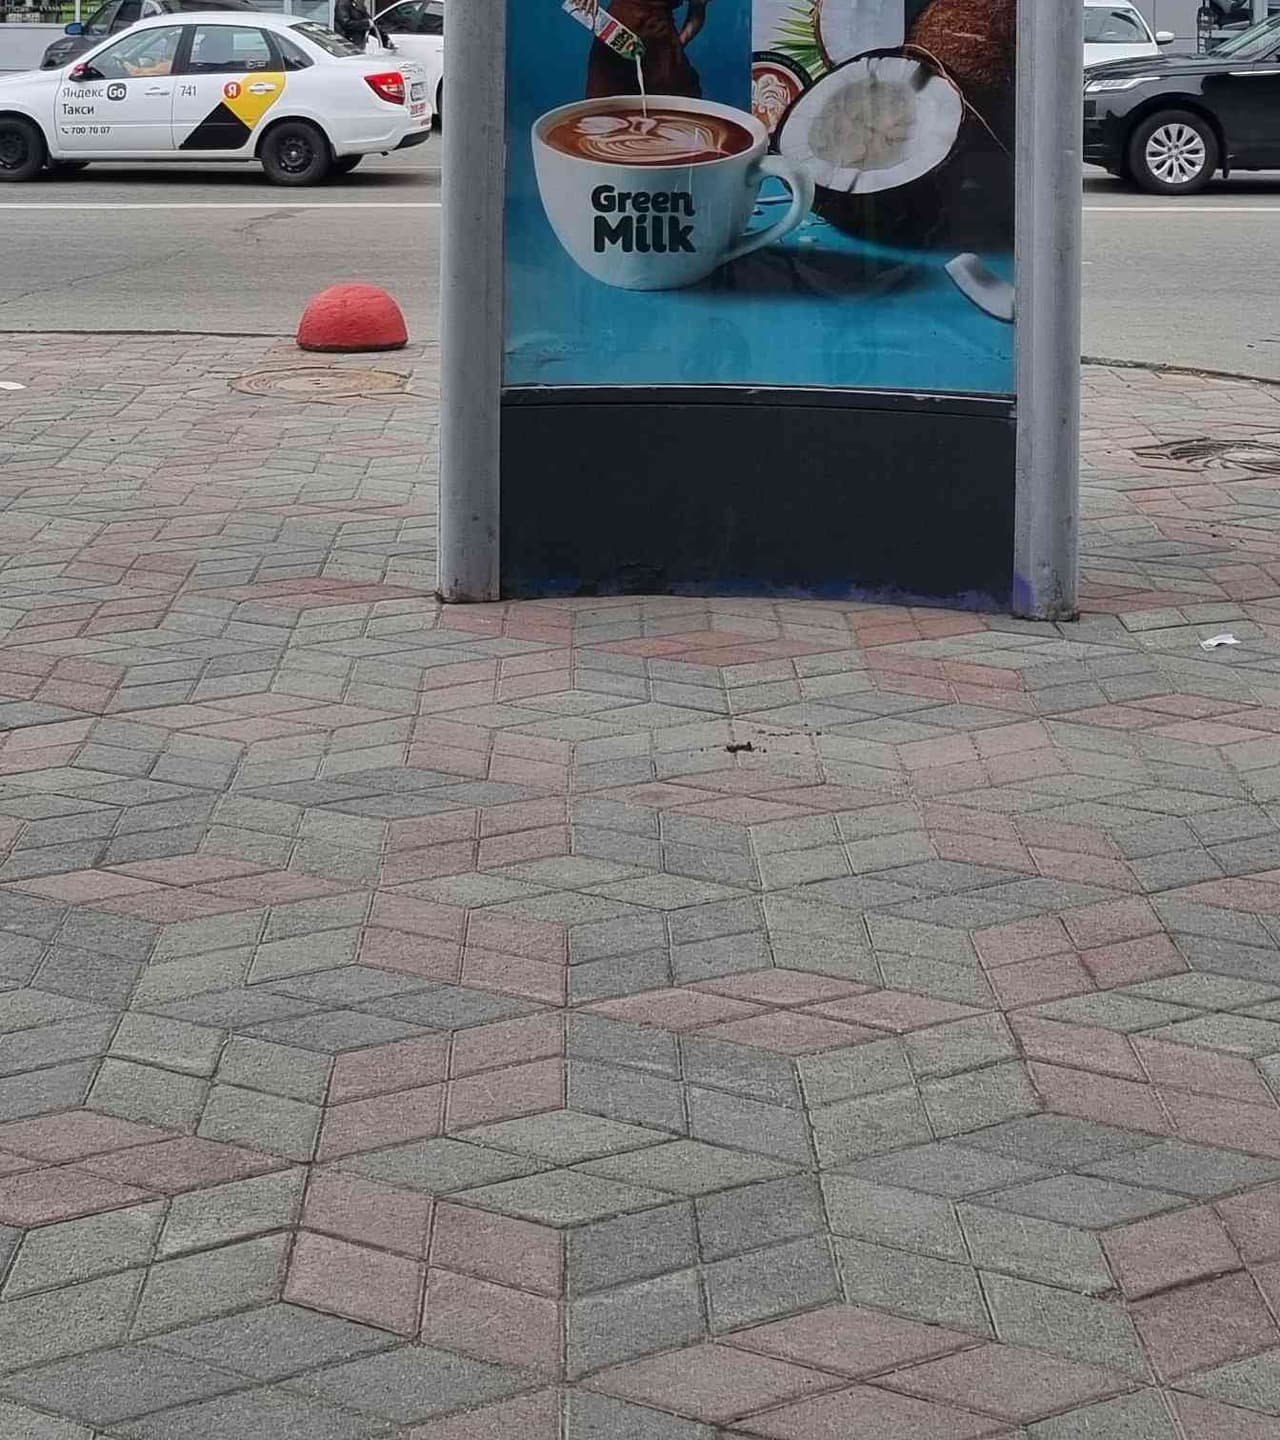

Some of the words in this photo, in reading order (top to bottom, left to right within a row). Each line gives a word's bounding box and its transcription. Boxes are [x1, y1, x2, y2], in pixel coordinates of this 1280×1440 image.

[62, 86, 104, 100] Яндекс
[107, 83, 126, 100] Go
[180, 85, 197, 97] 741
[62, 102, 95, 116] Такси
[590, 184, 695, 217] Green
[592, 214, 696, 254] Milk
